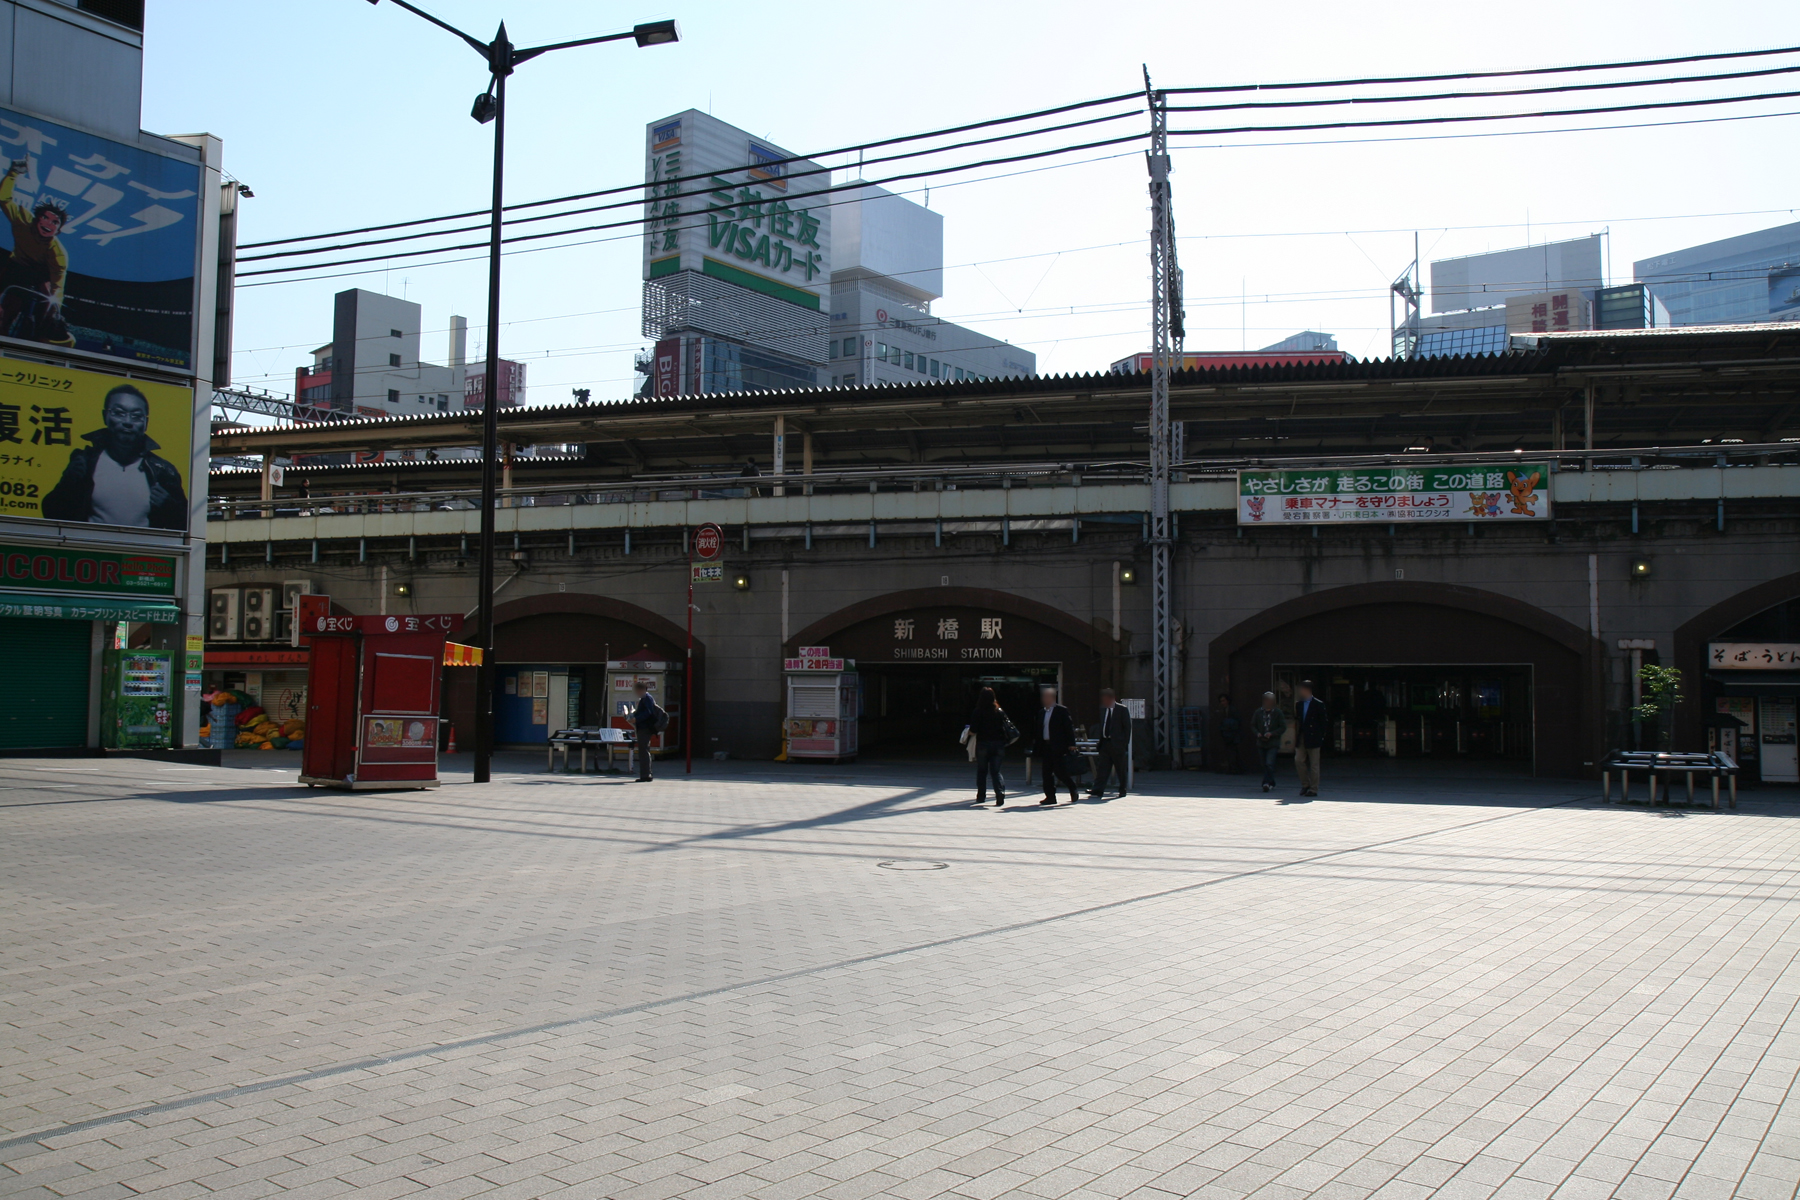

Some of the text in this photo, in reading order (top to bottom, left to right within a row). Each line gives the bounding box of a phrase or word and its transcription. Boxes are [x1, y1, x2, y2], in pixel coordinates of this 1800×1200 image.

[657, 128, 676, 142] VISA
[755, 155, 781, 176] VISA
[662, 151, 681, 252] 三井住友
[707, 175, 821, 251] 三井住友
[708, 213, 823, 281] VISAカード
[0, 371, 73, 390] ークリニック
[659, 355, 673, 393] BIG
[1246, 472, 1505, 494] やさしさが 走るこの街 この道路
[1284, 494, 1450, 510] 乗車マナーを守りましょう
[698, 537, 717, 549] 消火栓
[121, 562, 173, 572] Hello Photo
[701, 568, 722, 577] セキネ
[71, 607, 176, 623] カラープリントスピード仕上げ
[327, 617, 353, 631] 宝くじ
[405, 615, 452, 632] 宝くじ
[893, 617, 1003, 640] 新橋駅
[799, 647, 829, 658] この売場
[893, 648, 1002, 659] SHIMBASHI STATION
